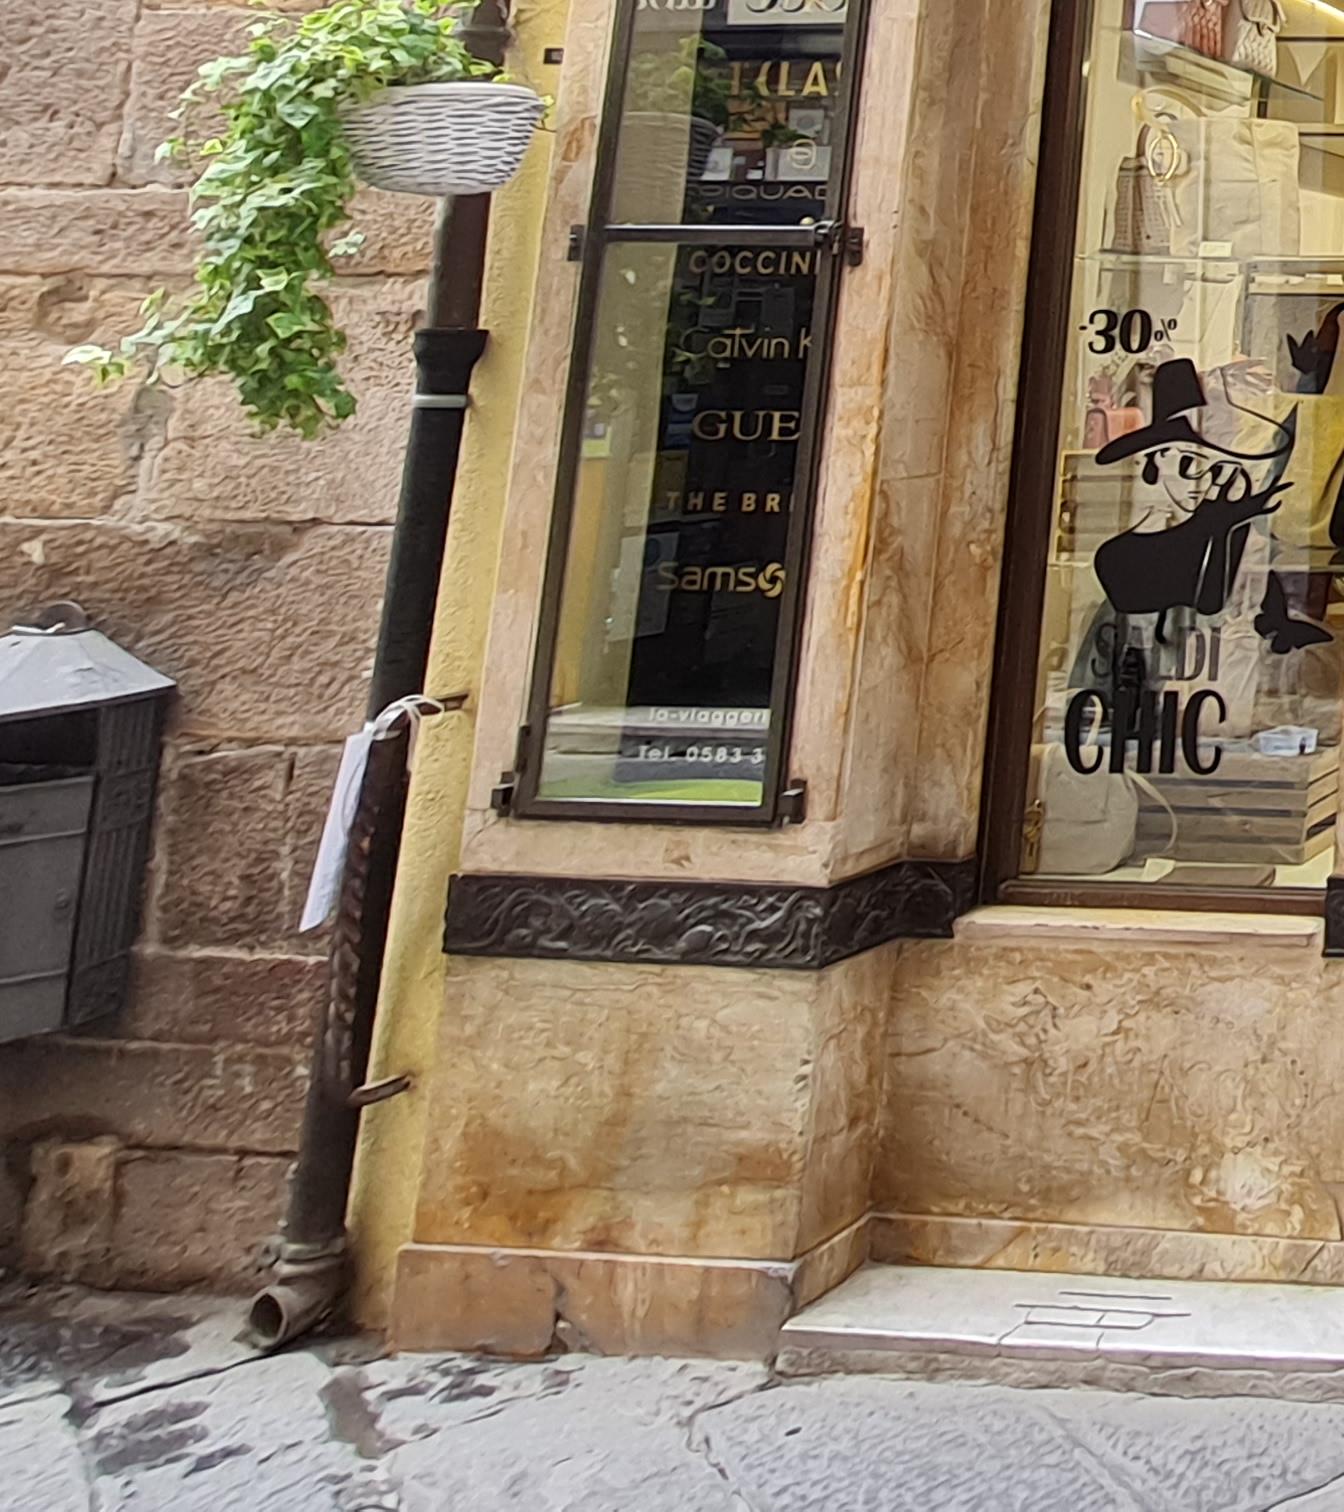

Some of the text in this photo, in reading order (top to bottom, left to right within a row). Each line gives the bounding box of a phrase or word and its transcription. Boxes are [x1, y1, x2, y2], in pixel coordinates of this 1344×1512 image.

[1078, 308, 1178, 356] -30%
[691, 409, 803, 442] GUE
[665, 490, 730, 513] THE
[1091, 621, 1223, 682] SALDI
[1063, 688, 1228, 777] CHIC
[685, 745, 743, 764] 0583
